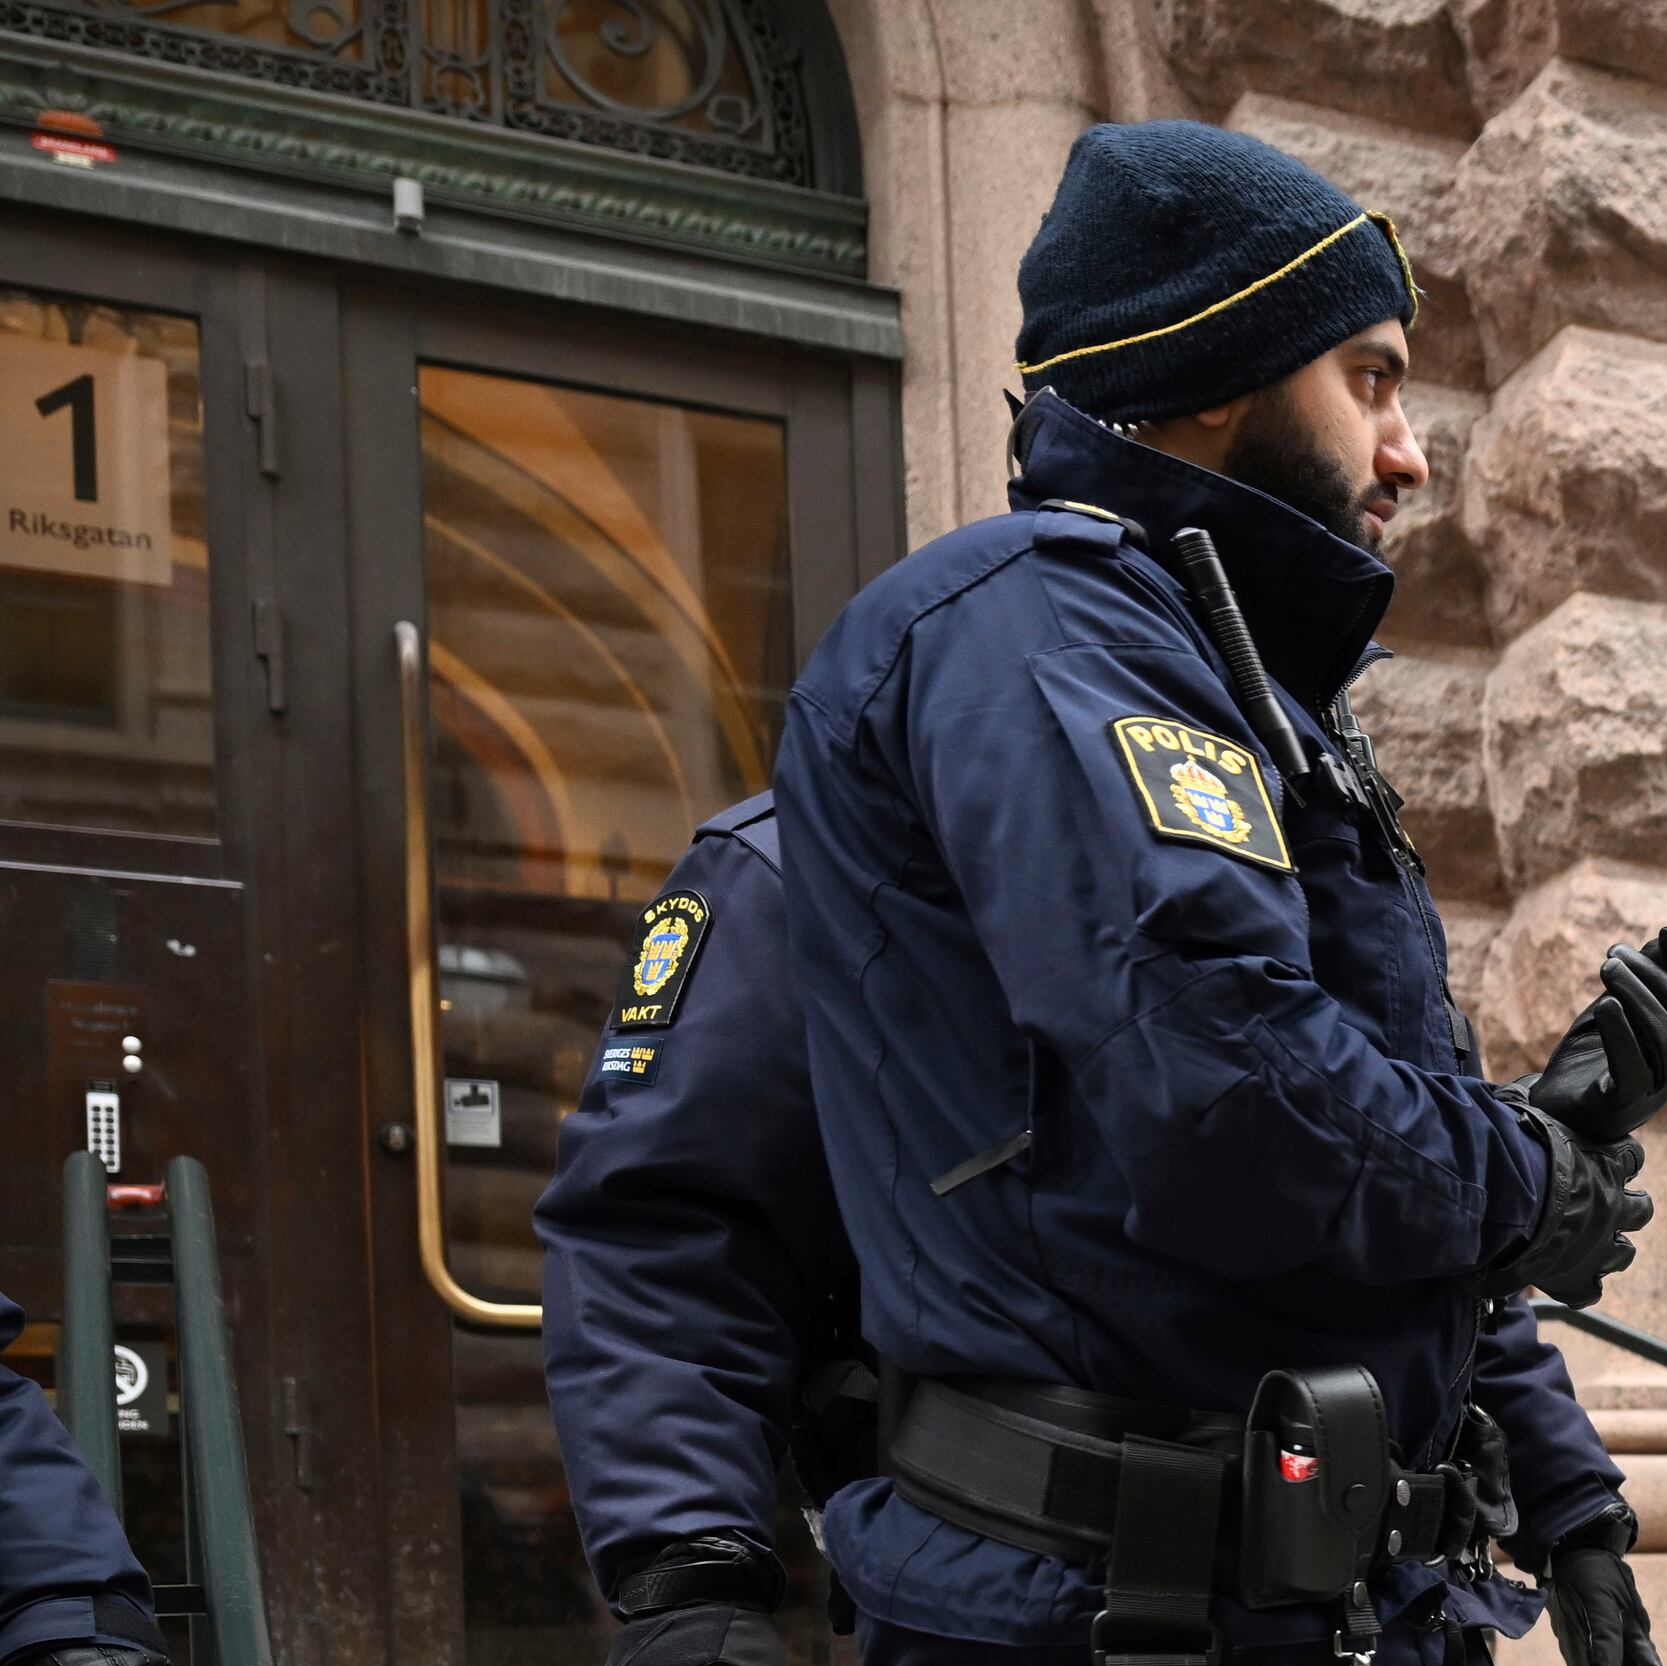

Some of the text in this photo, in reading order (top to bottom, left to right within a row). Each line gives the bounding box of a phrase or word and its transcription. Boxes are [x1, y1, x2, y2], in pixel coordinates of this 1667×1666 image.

[35, 373, 98, 503] 1
[8, 507, 153, 550] Riksgatan
[1126, 725, 1247, 775] POLIS
[643, 897, 704, 924] SKYDDS
[621, 1004, 662, 1022] VAKT
